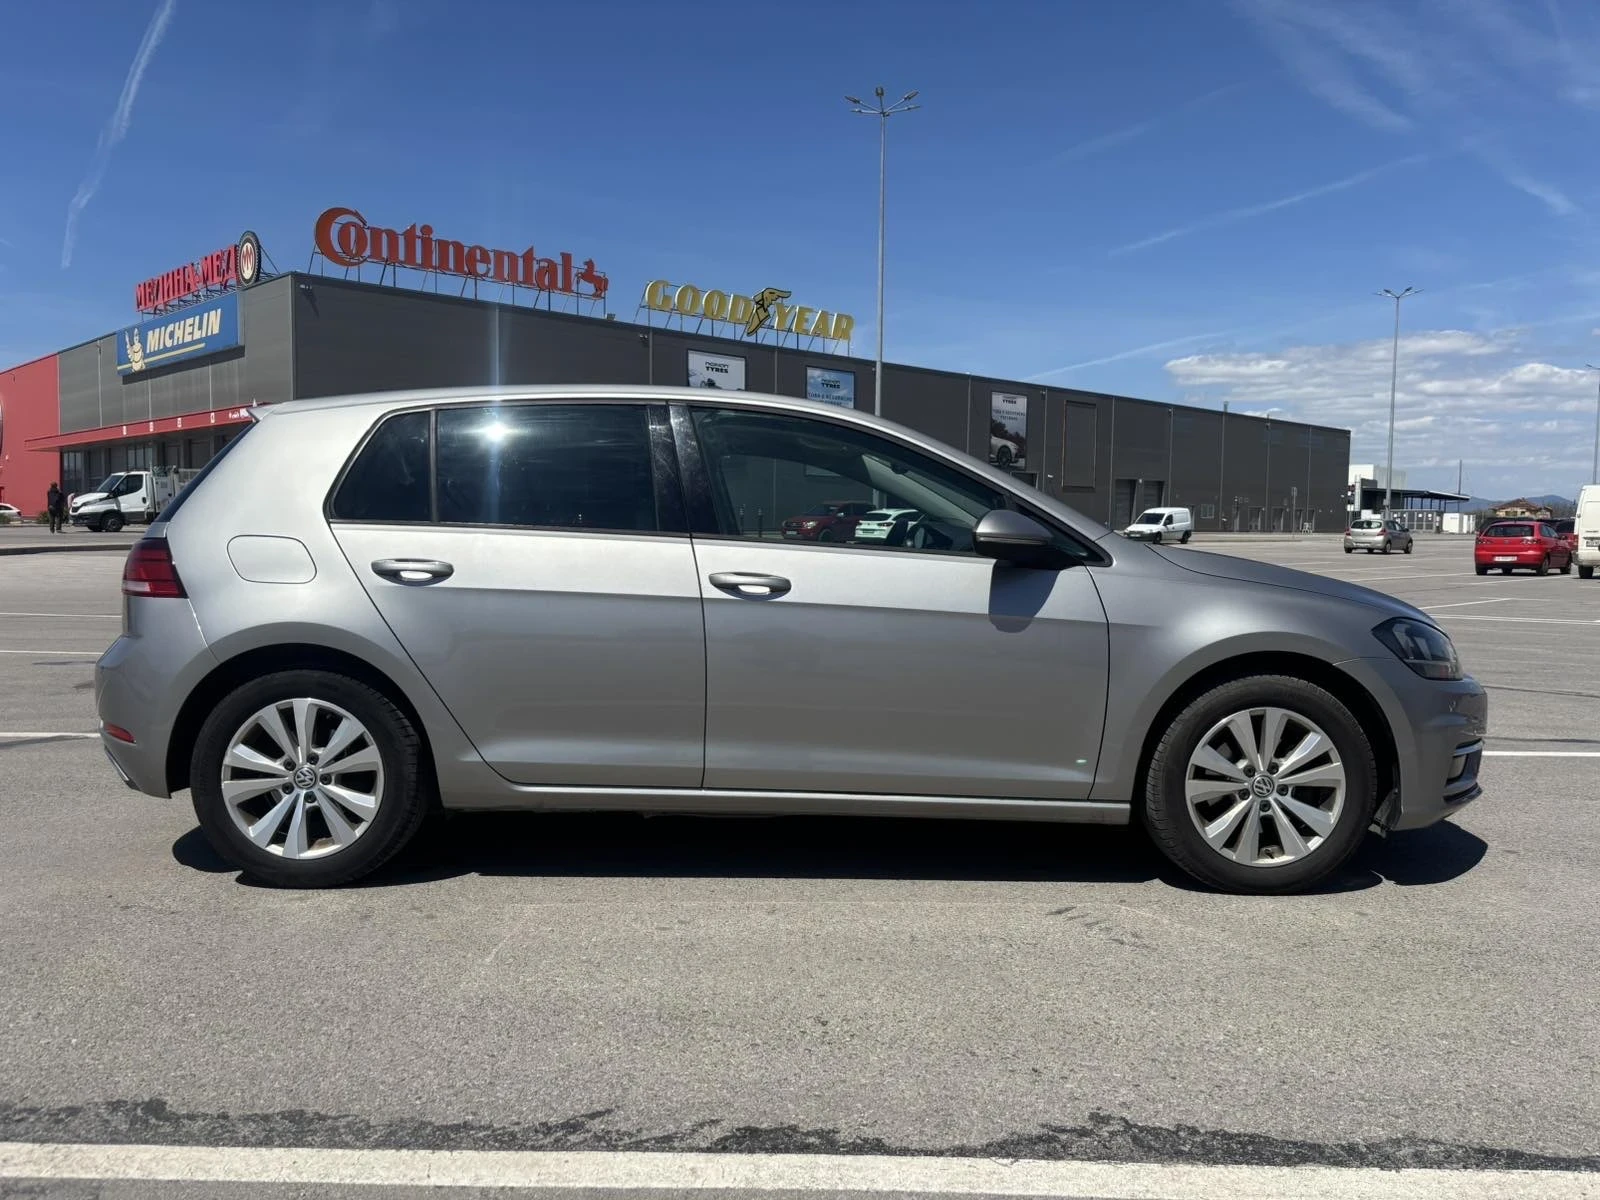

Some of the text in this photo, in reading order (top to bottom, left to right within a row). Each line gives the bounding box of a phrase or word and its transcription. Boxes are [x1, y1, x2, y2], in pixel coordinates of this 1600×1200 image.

[314, 206, 573, 294] Continental
[146, 308, 222, 354] MICHELIN
[705, 366, 729, 374] TYRES
